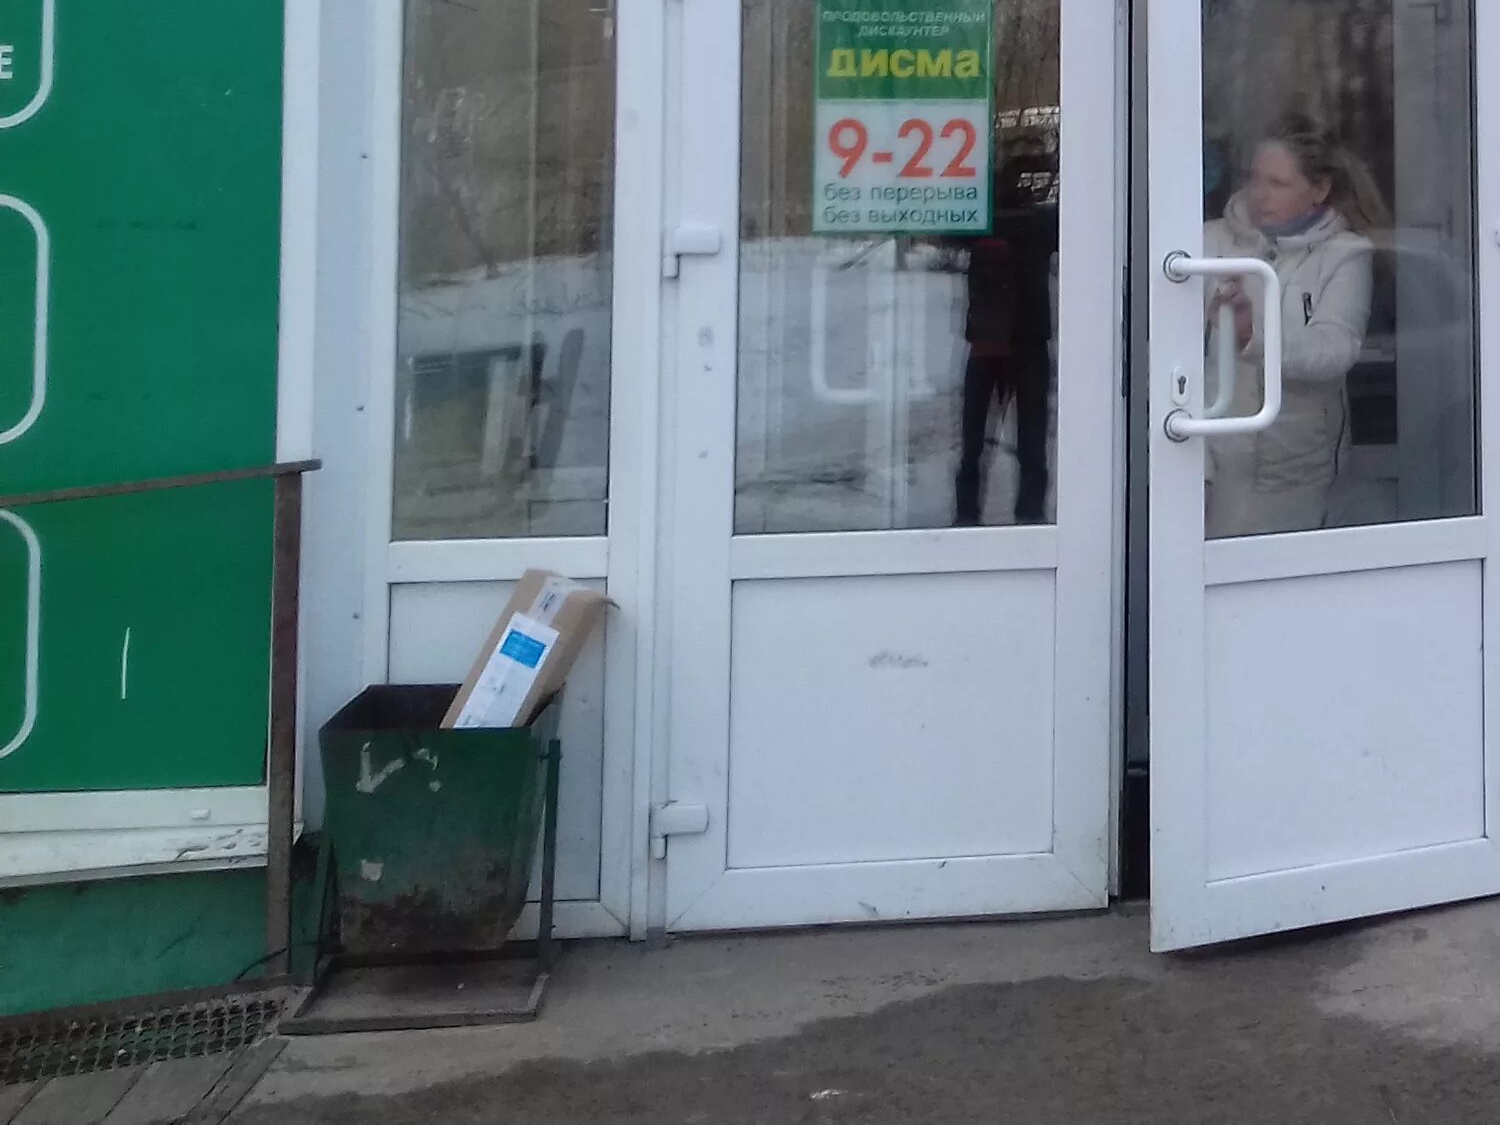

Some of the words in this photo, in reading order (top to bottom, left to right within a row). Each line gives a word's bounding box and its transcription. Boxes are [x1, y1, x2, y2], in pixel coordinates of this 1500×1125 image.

[858, 25, 950, 38] ДИСКАУНТЕР
[827, 48, 980, 78] дисма
[828, 118, 977, 179] 9-22
[824, 183, 861, 201] без
[870, 185, 978, 204] перерыва
[824, 205, 861, 223] без
[868, 208, 978, 225] выходных
